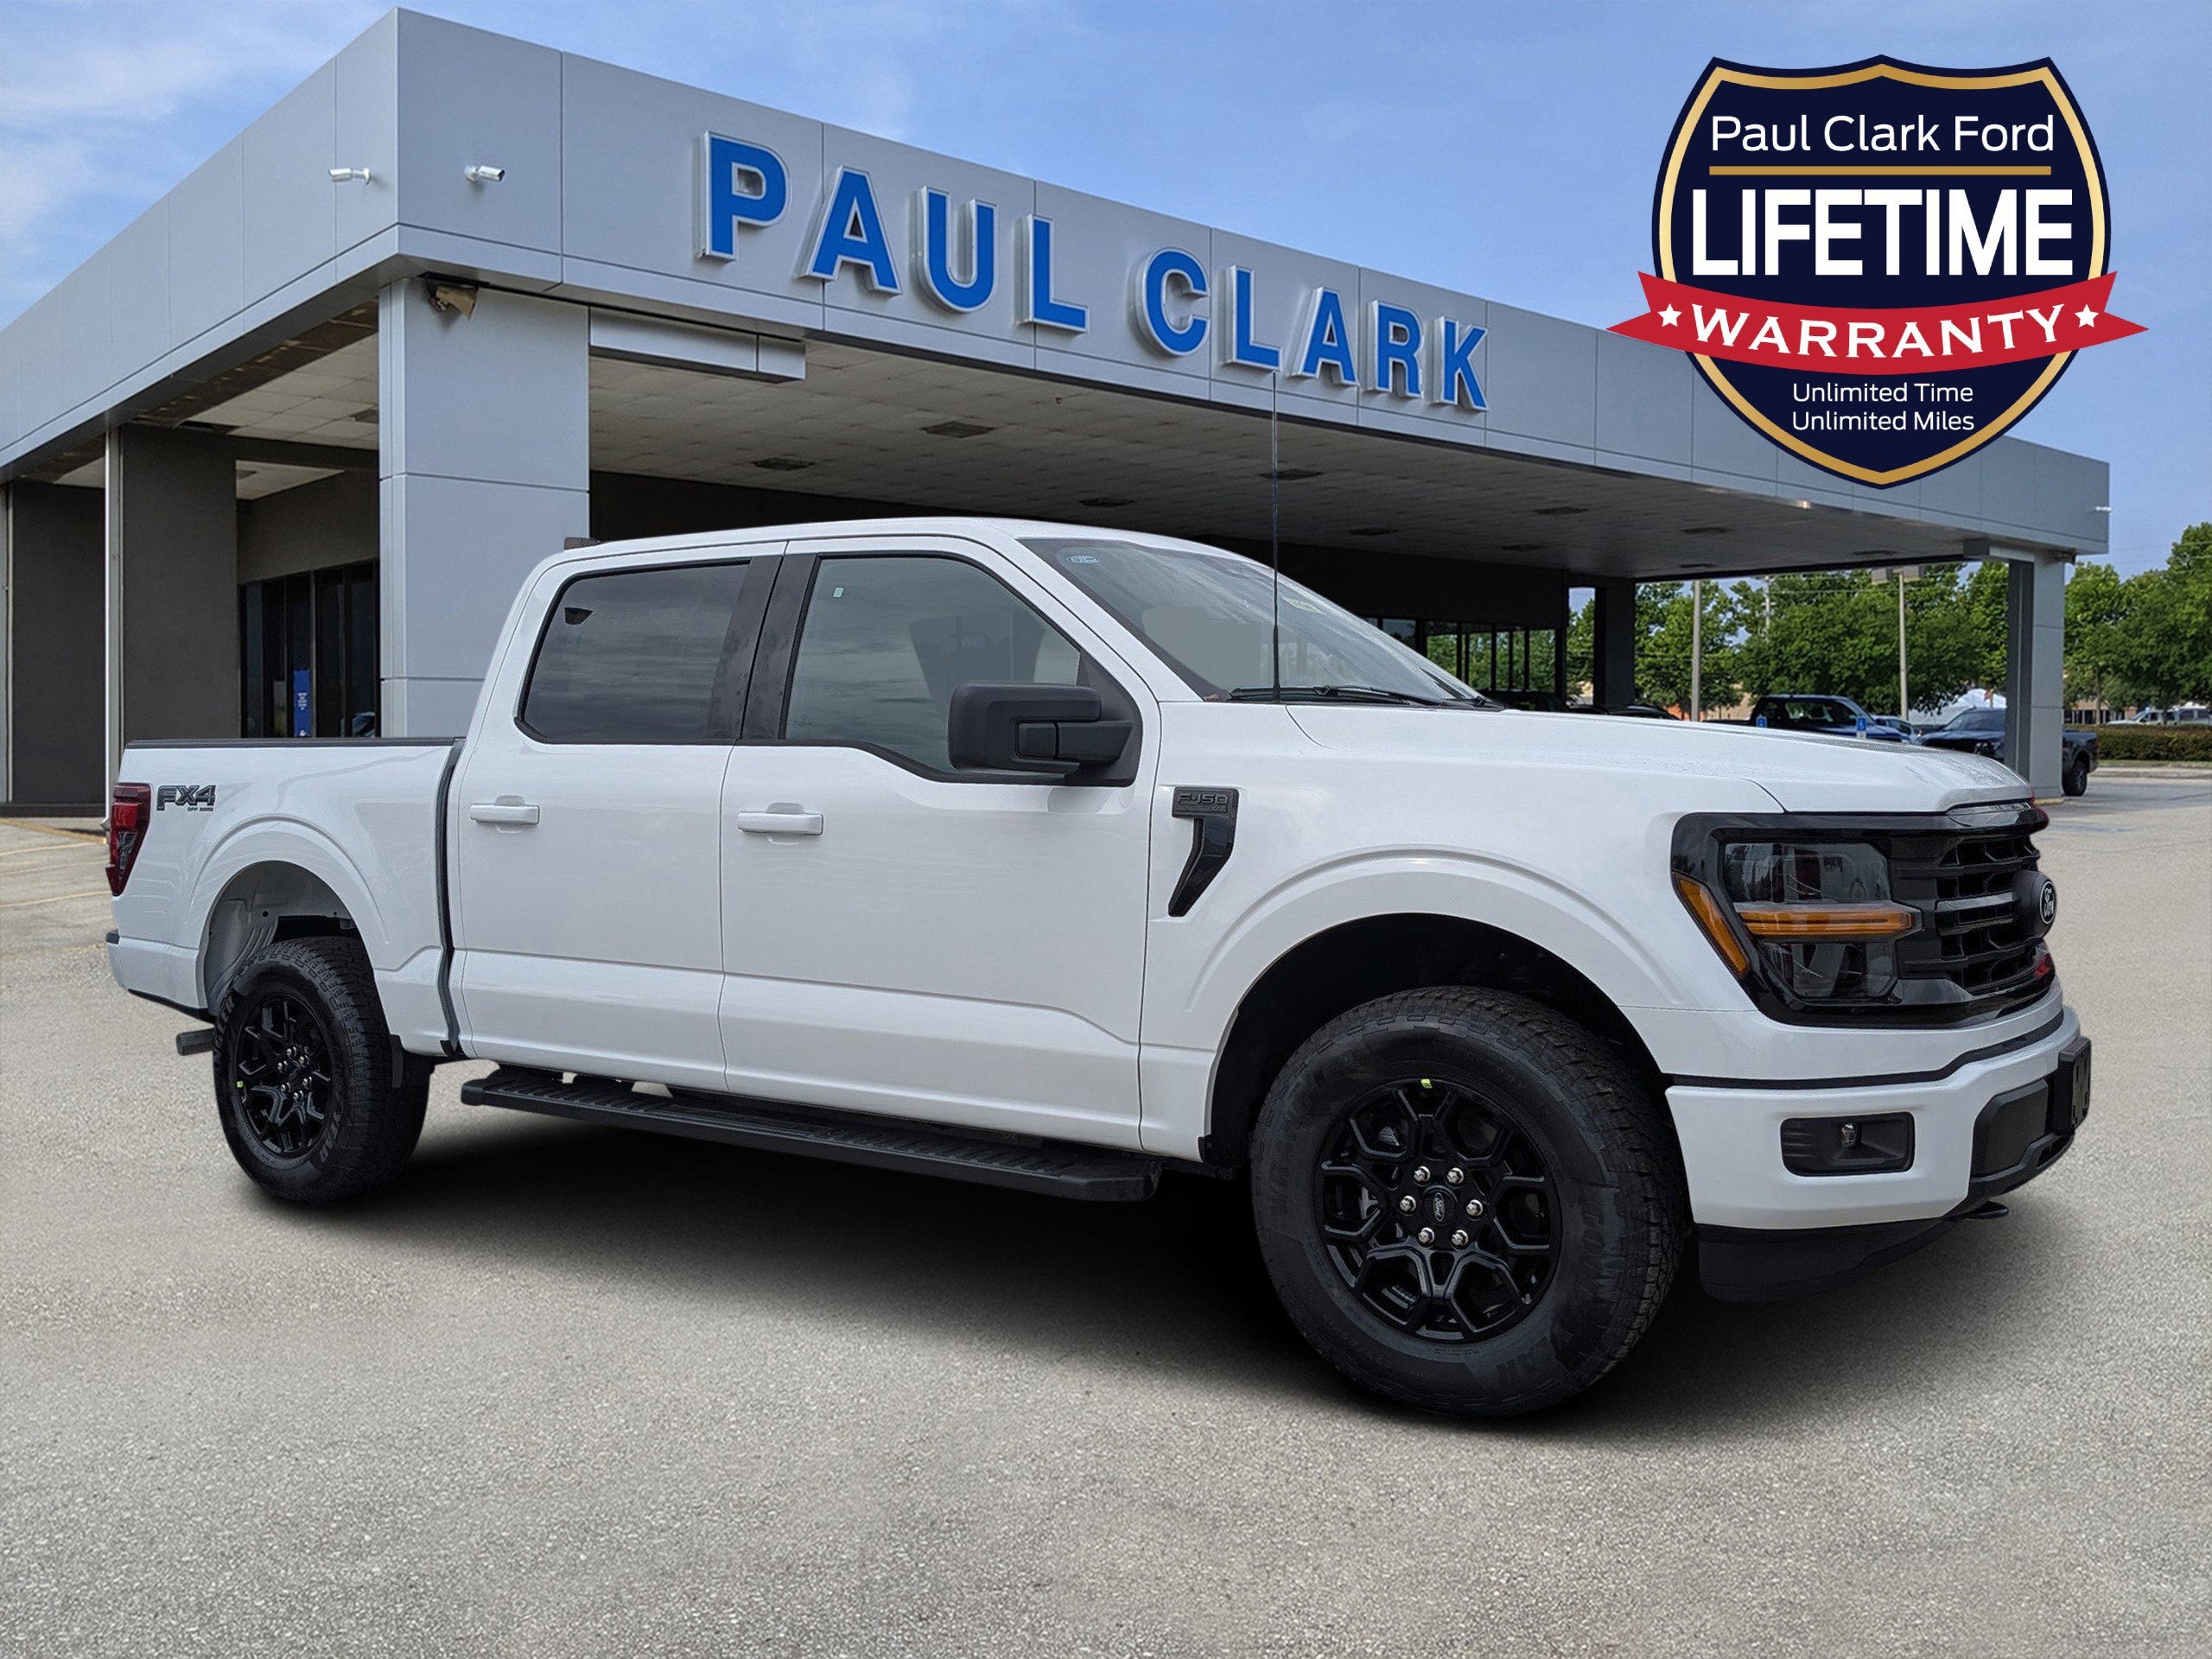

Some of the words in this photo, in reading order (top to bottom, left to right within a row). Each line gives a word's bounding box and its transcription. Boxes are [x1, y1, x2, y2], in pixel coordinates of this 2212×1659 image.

[700, 130, 1088, 334] PAUL
[1136, 247, 1488, 411] CLARK
[156, 785, 216, 810] FX4
[1176, 793, 1230, 805] F-150
